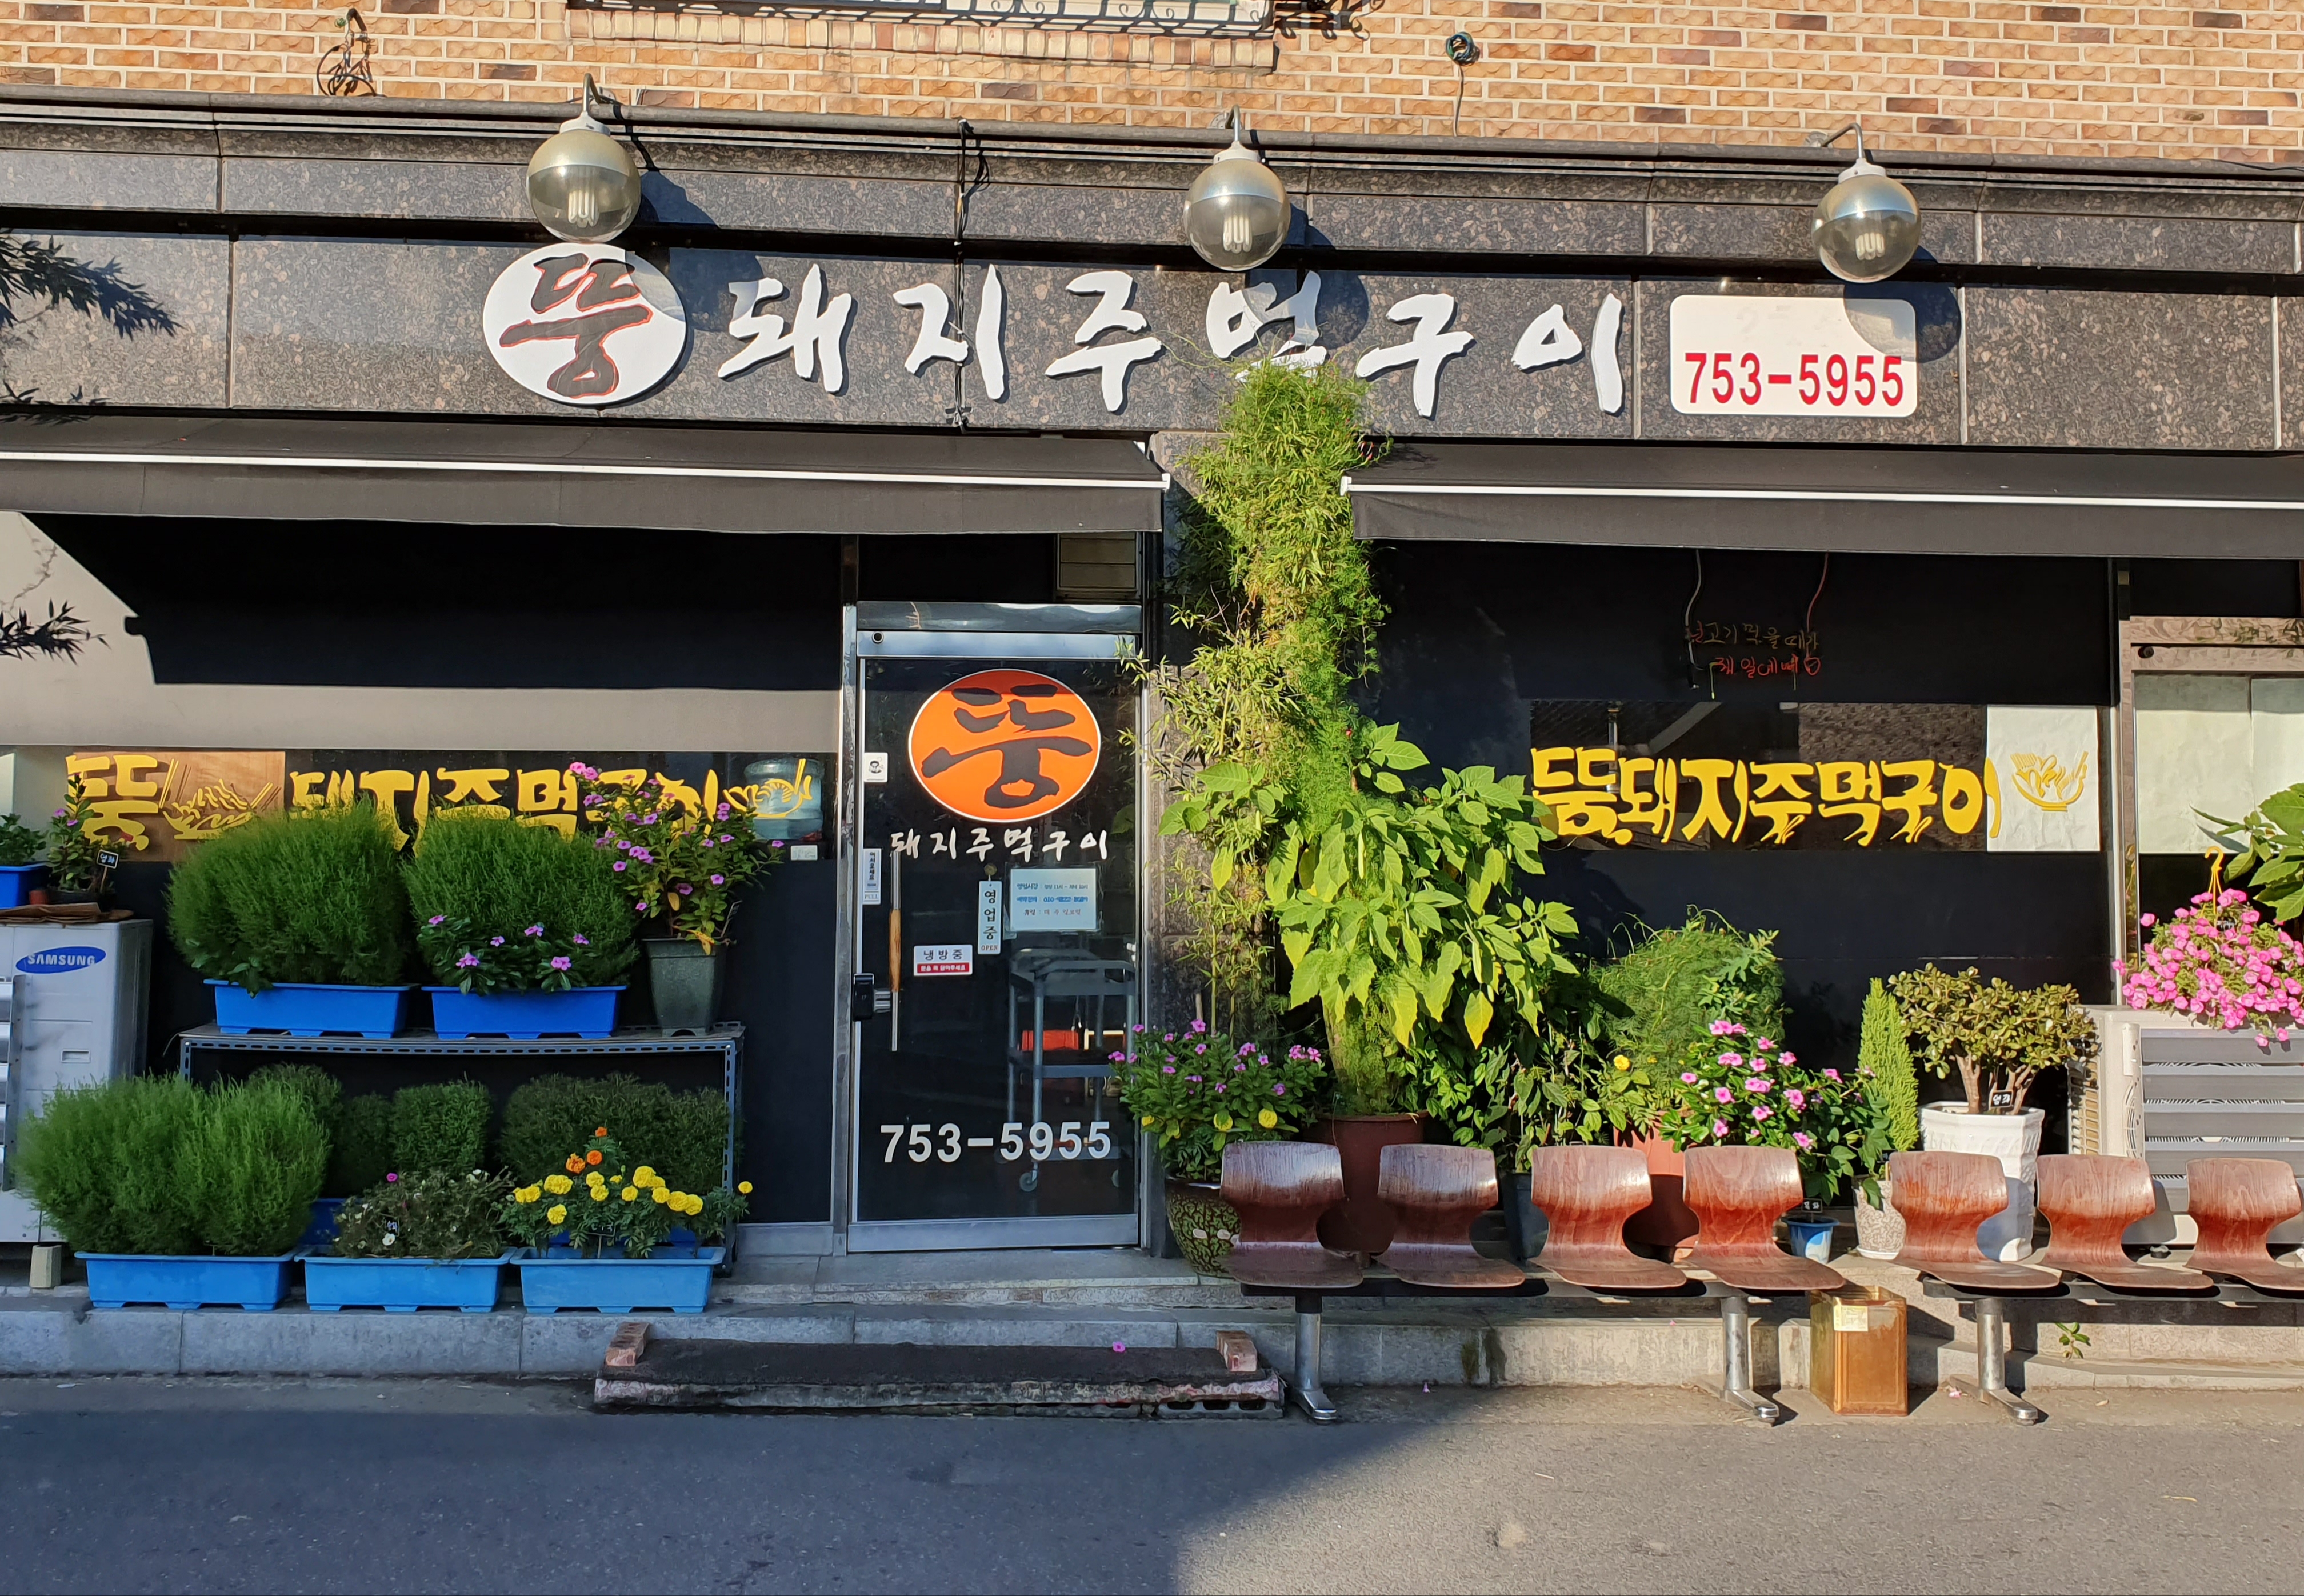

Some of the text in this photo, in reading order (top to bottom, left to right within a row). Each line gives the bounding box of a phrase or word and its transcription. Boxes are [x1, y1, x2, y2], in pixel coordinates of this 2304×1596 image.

[499, 252, 653, 398] 뚱
[1685, 352, 1903, 406] 753-5955
[921, 684, 1092, 809] 뚱
[66, 754, 158, 851] 뚱
[983, 890, 998, 940] 영업중
[27, 953, 96, 966] SAMSUNG
[923, 949, 963, 961] 냉방중
[880, 1121, 1111, 1163] 753-5955
